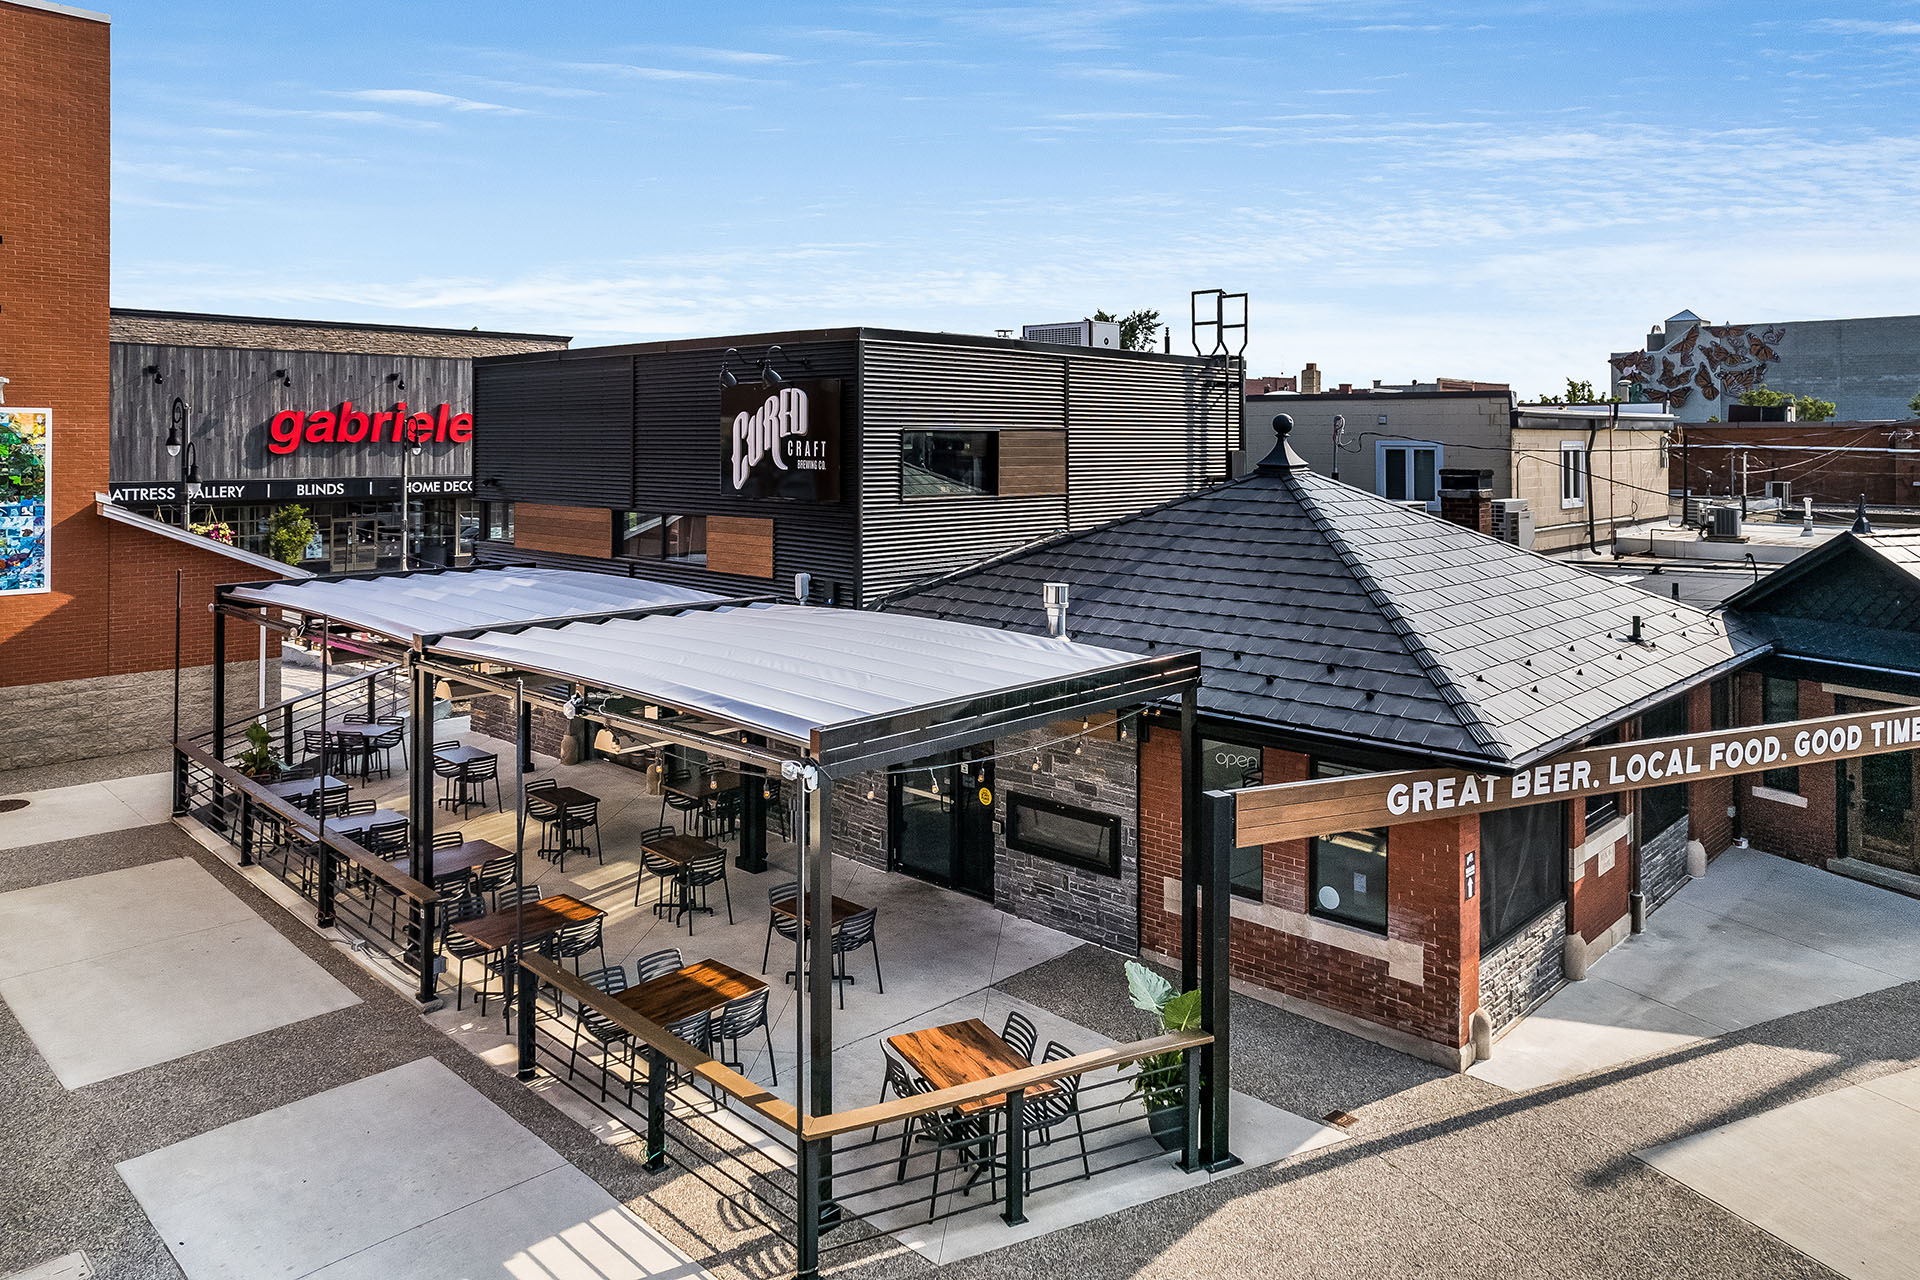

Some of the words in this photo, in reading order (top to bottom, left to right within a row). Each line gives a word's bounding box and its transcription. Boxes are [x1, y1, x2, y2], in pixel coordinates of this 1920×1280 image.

[268, 401, 472, 455] gabriele
[731, 387, 808, 490] CURED
[787, 440, 827, 457] CRAFT
[797, 459, 817, 470] BREWING
[818, 460, 826, 470] CO.
[108, 487, 176, 501] ATTRESS
[296, 482, 345, 496] BLINDS
[1215, 752, 1258, 769] open
[1387, 775, 1501, 815] GREAT
[1511, 760, 1600, 799] BEER.
[1609, 746, 1701, 785] LOCAL
[1709, 736, 1788, 771] FOOD.
[1794, 725, 1863, 758] GOOD
[1870, 716, 1920, 747] TIME
